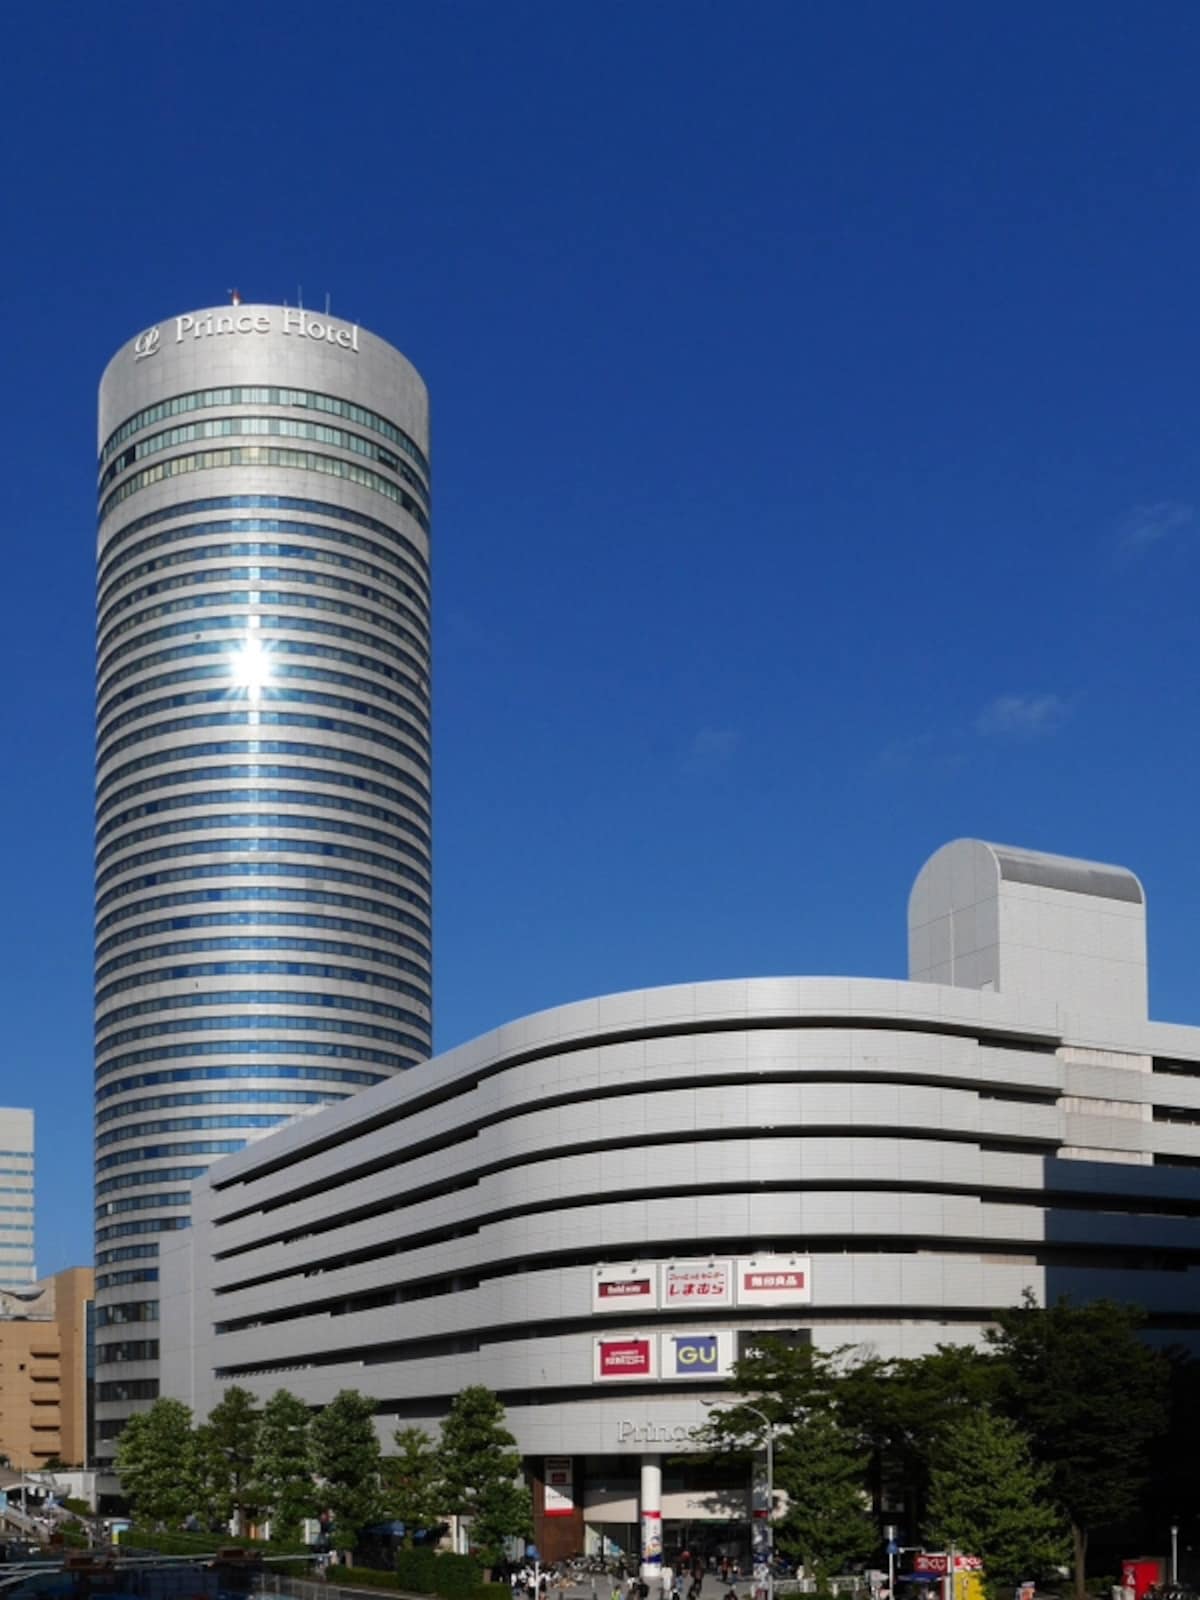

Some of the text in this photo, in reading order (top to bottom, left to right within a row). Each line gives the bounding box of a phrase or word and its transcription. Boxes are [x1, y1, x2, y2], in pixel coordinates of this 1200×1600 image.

[175, 309, 361, 352] Prince Hotel
[669, 1281, 724, 1297] しまむら
[678, 1346, 717, 1365] GU
